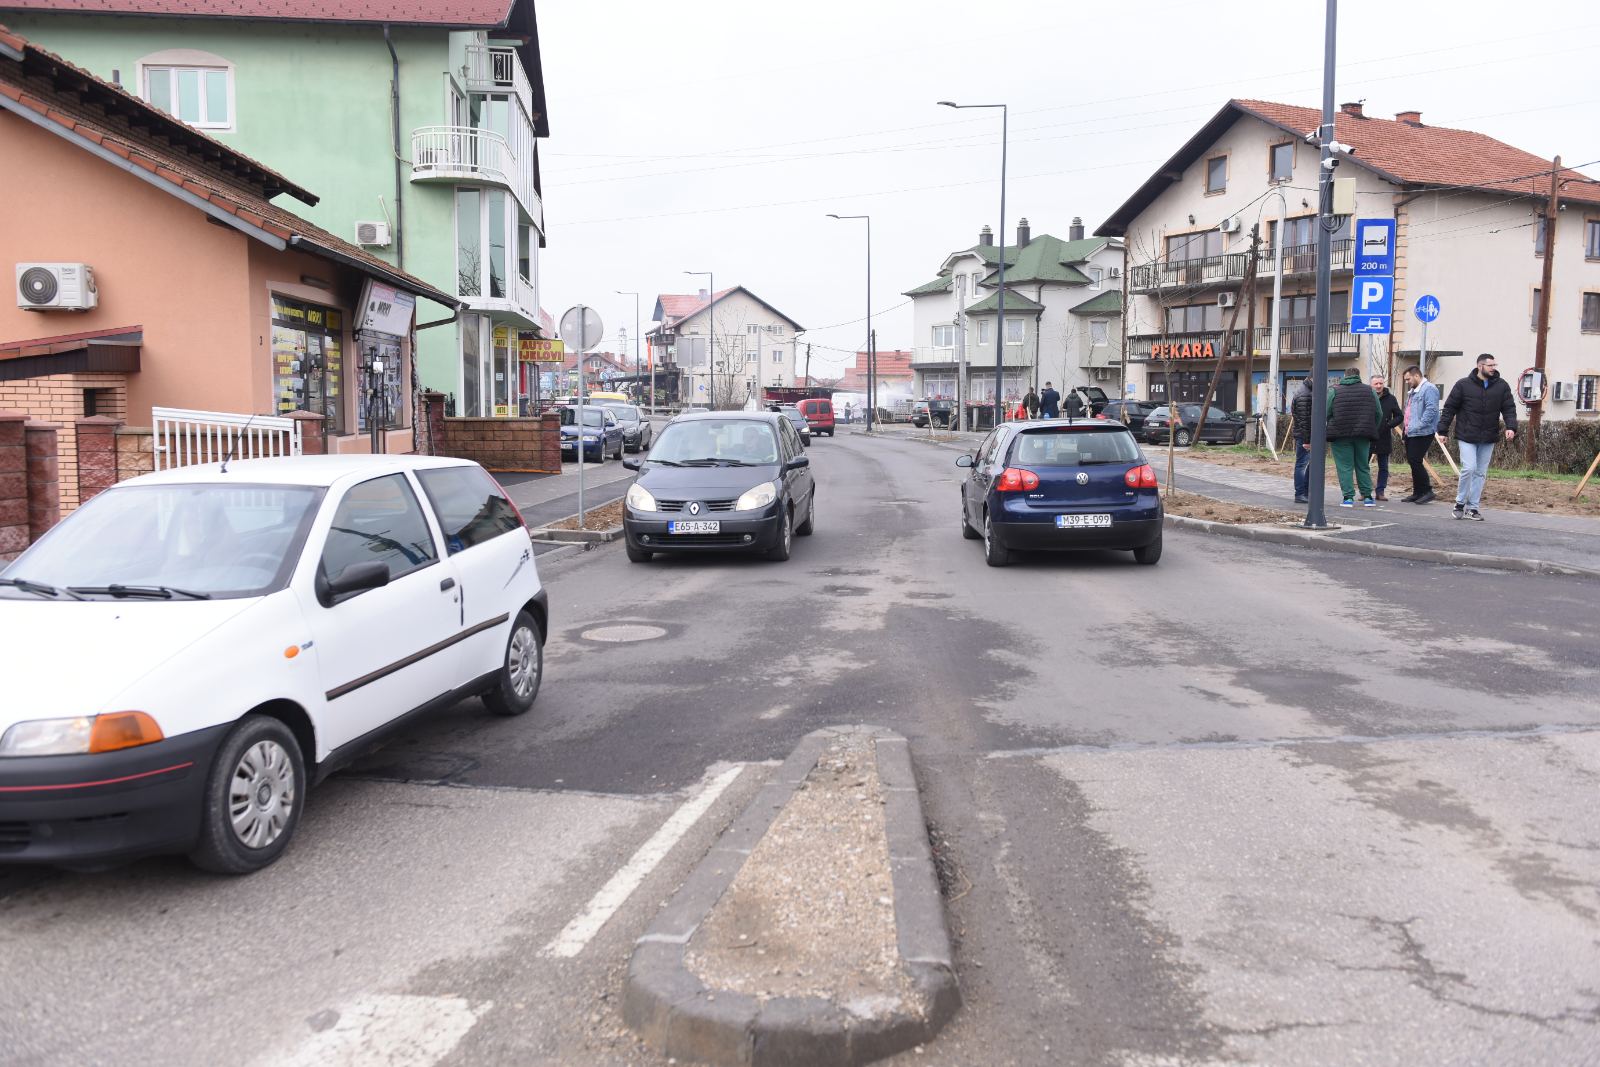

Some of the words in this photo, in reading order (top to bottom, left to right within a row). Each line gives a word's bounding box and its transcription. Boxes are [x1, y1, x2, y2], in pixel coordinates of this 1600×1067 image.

[1361, 262, 1378, 270] 200
[1361, 281, 1384, 310] P
[521, 340, 552, 351] AUTO
[1151, 342, 1214, 360] PEKARA
[1150, 384, 1164, 393] PEK
[1063, 515, 1110, 525] M39-E-099
[675, 522, 718, 531] E65-A-342
